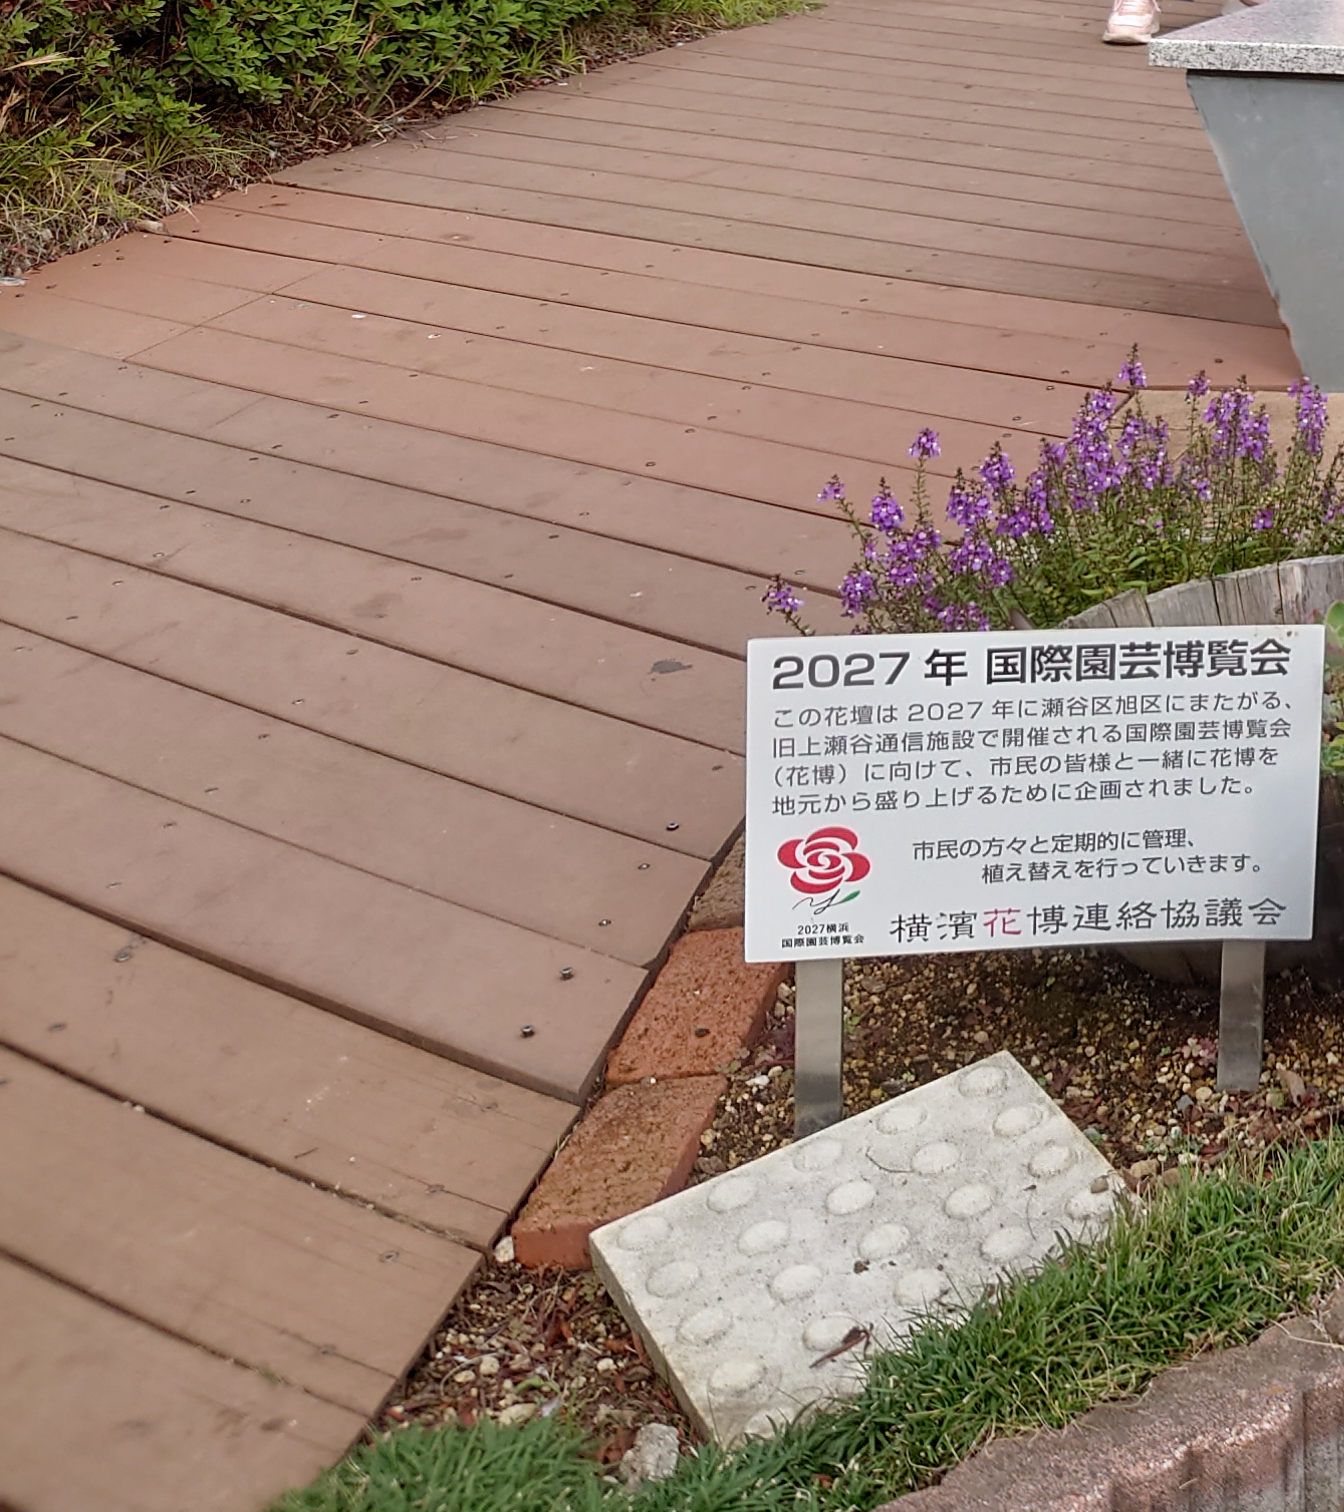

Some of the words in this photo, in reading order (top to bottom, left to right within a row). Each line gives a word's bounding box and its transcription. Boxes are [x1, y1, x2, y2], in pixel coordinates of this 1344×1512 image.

[987, 637, 1291, 684] 国際園芸博覧会
[773, 717, 1291, 758] 旧上瀬谷通信施設で開催される国際園芸博覧会
[772, 776, 1253, 815] 地元から盛り上げるために企画されました。
[913, 828, 1195, 860] 市民の方々と定期的に管理、
[982, 854, 1261, 884] 植え替えを行っていきます。
[798, 922, 849, 935] 2027横浜
[890, 898, 1287, 943] 横濱花博連絡協議会
[782, 934, 864, 948] 国際園芸博覧会
